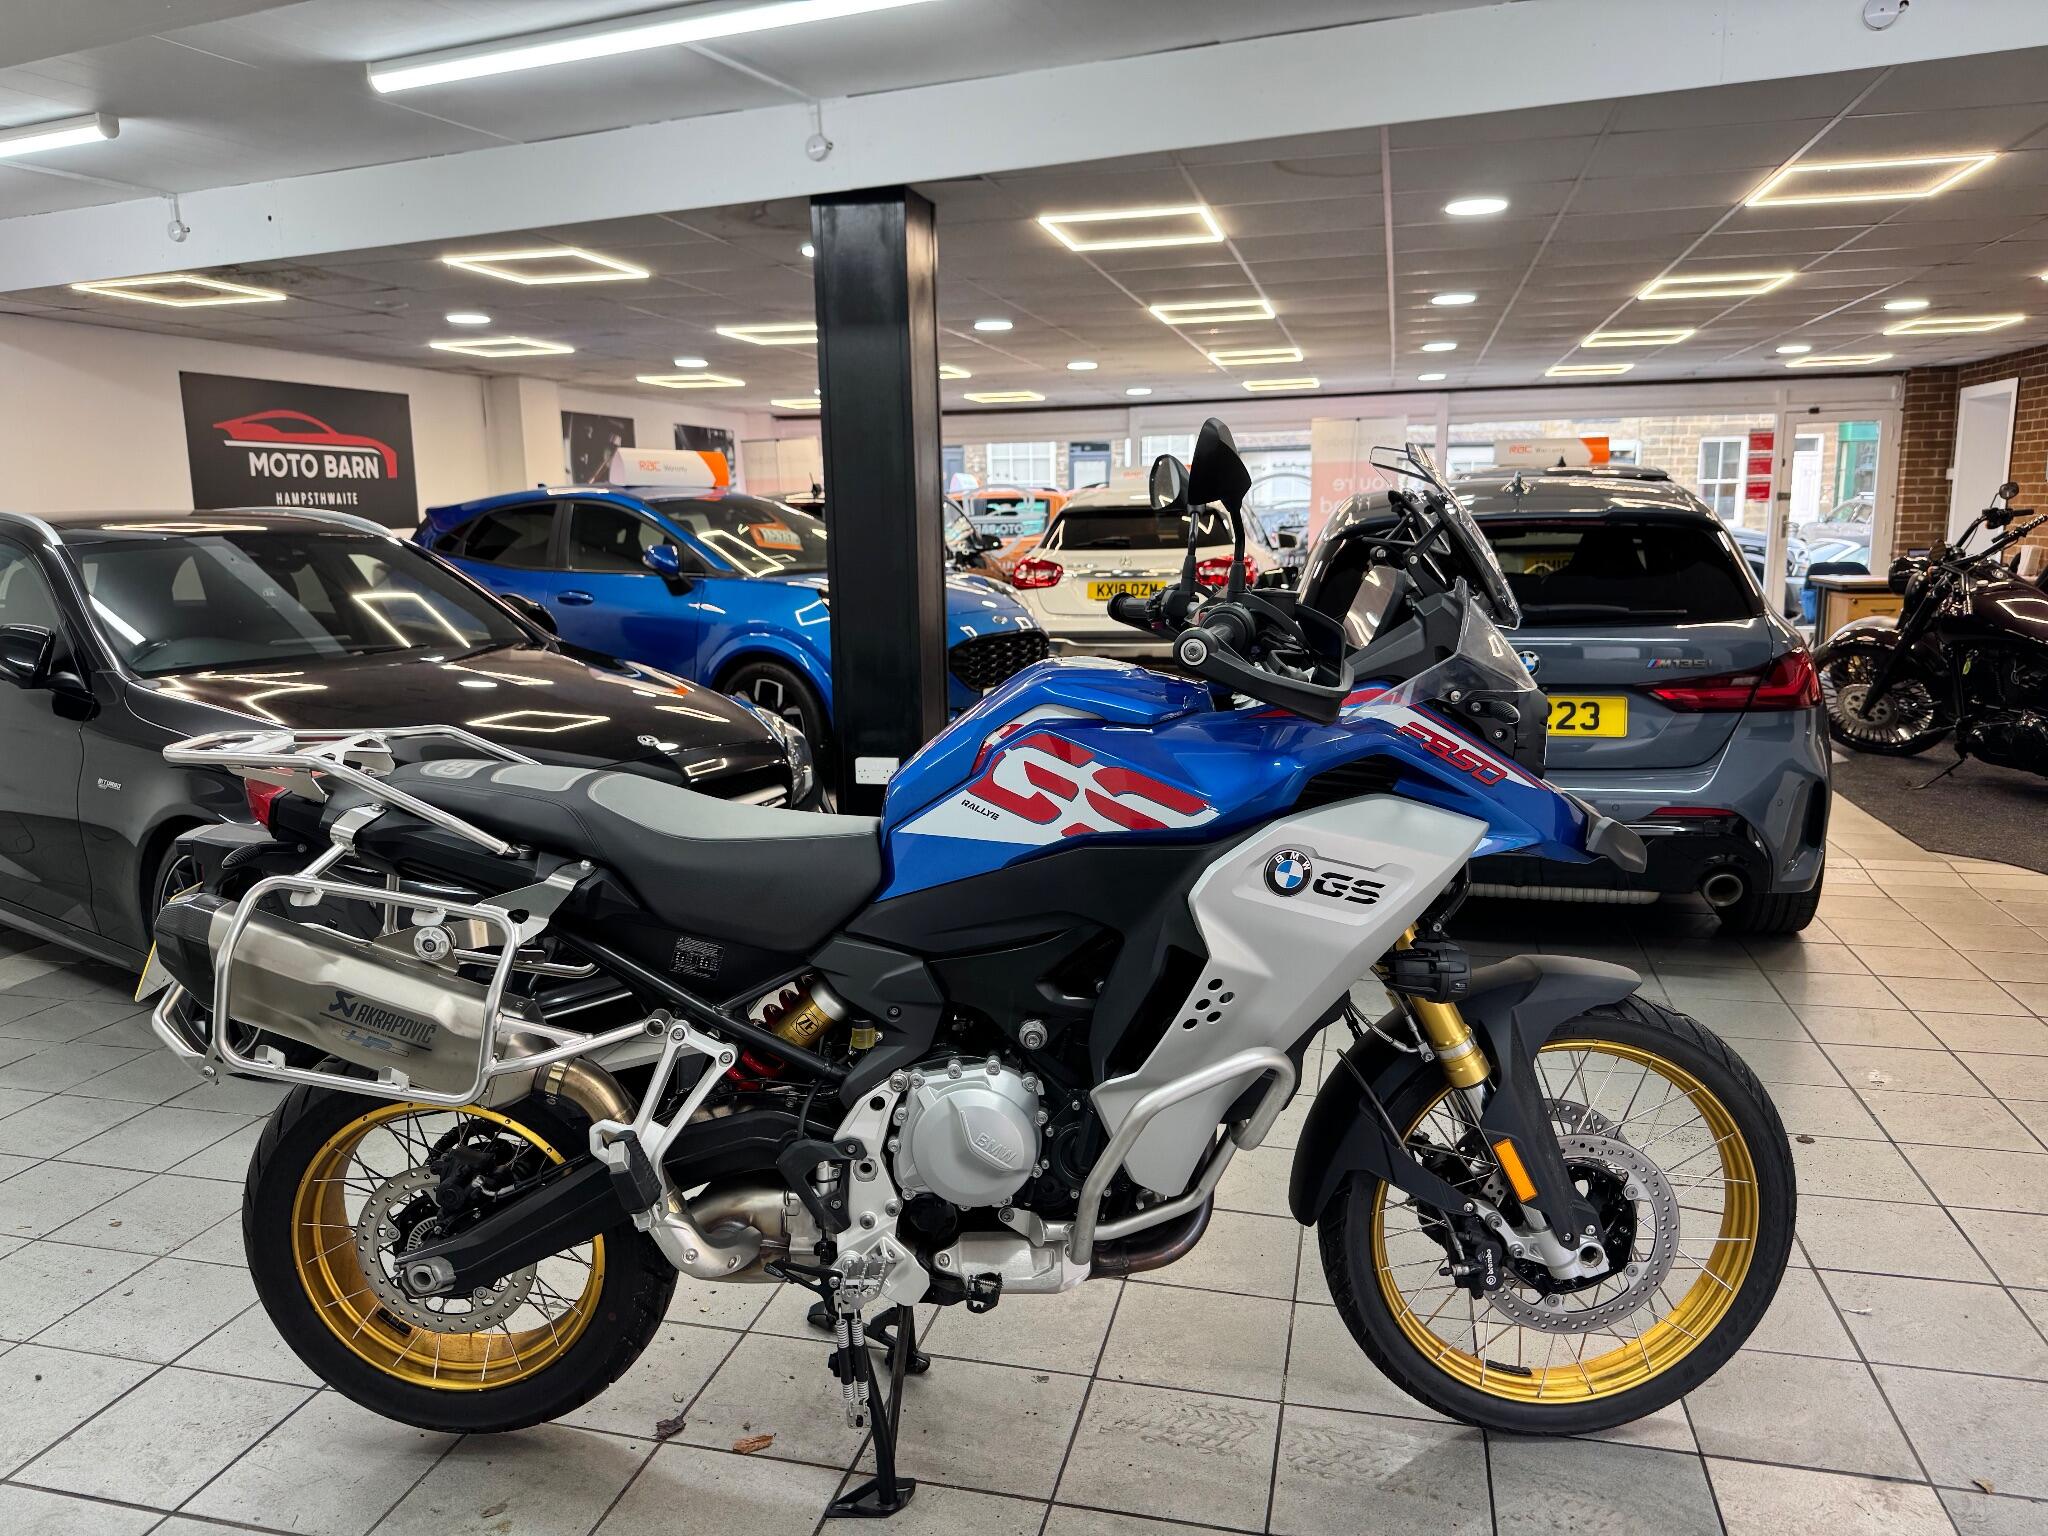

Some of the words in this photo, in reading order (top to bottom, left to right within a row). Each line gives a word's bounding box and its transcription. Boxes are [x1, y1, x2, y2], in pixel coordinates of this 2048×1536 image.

[249, 451, 319, 478] MOTO
[323, 454, 380, 479] BARN
[275, 491, 359, 506] HAMPSTHWAITE
[961, 799, 1000, 821] RALLYE
[1312, 872, 1386, 905] GS
[355, 1004, 437, 1044] AKRAPOVIČ
[975, 1132, 1018, 1164] BMW
[1486, 1248, 1495, 1275] brembo
